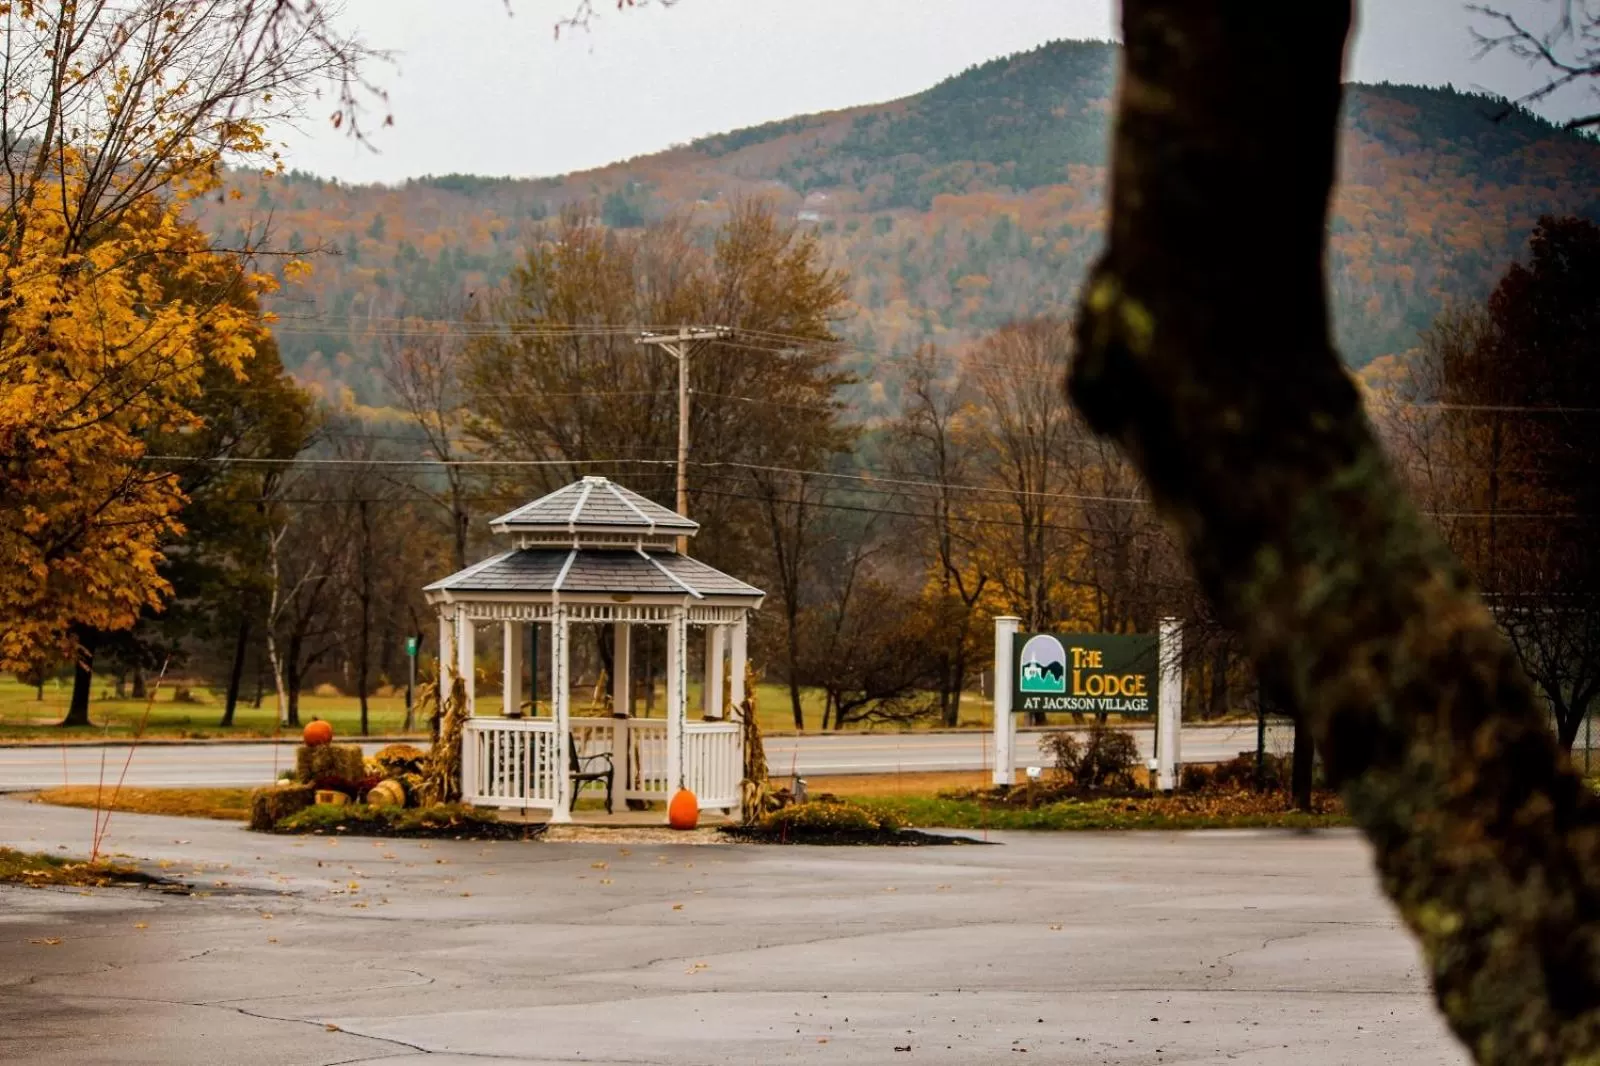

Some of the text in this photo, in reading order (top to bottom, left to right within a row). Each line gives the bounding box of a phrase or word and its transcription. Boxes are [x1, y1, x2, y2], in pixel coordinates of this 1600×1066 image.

[1070, 647, 1103, 668] THE
[1072, 669, 1147, 696] LODGE
[1024, 697, 1149, 711] AT JACKSON VILLAGE
